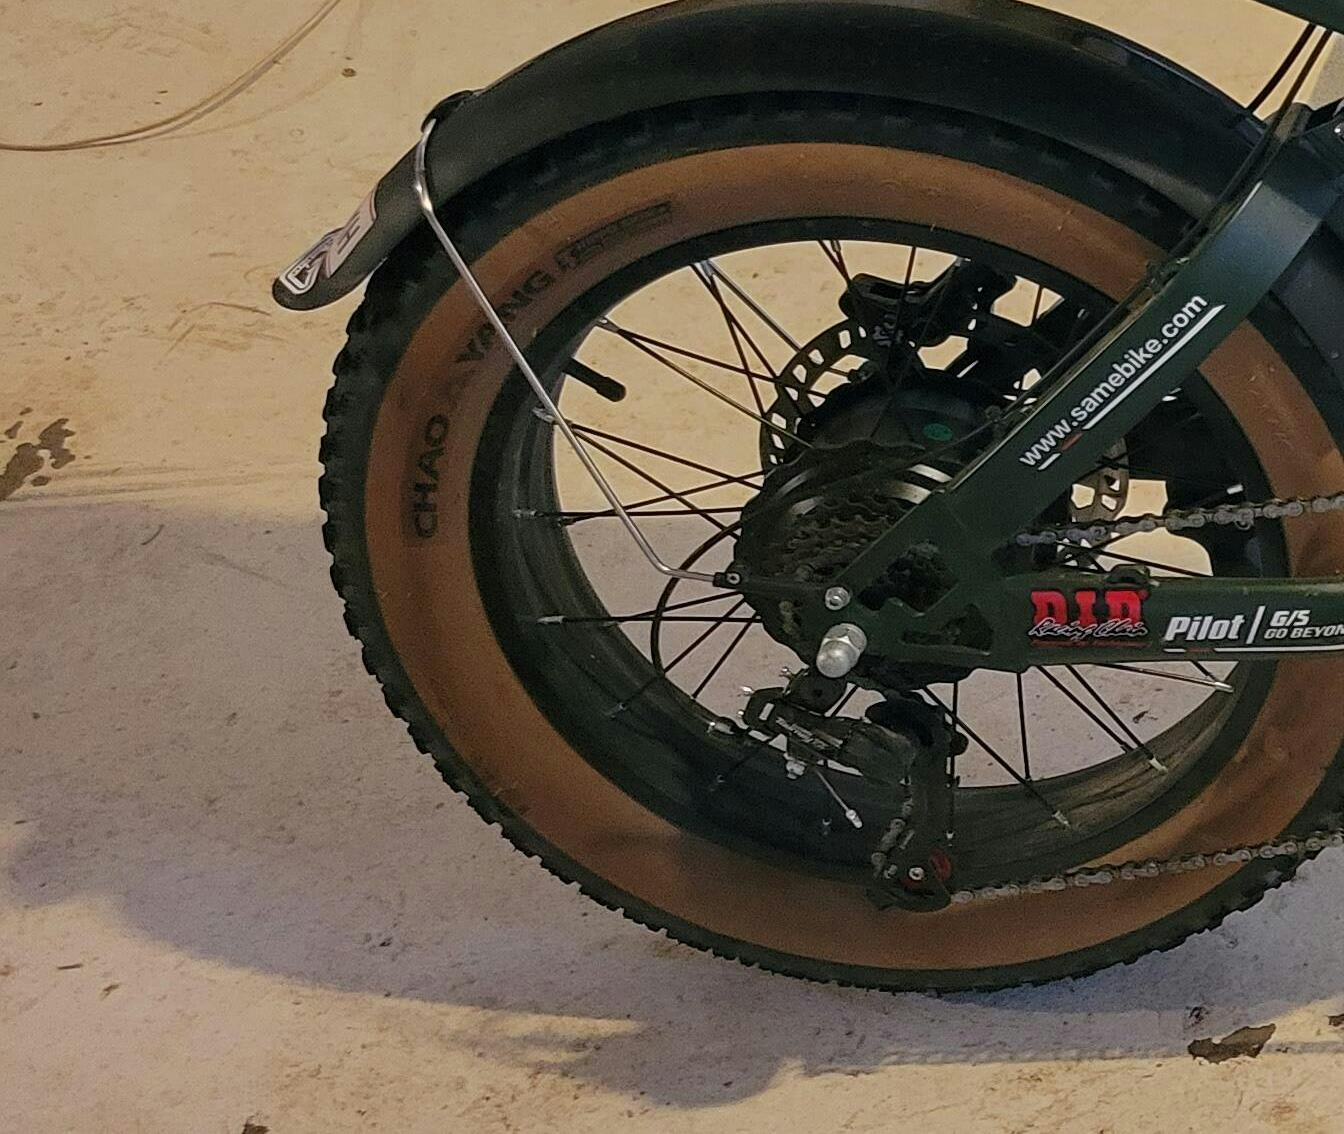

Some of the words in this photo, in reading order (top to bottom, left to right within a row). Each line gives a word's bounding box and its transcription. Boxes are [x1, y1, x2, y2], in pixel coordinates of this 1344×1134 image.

[1018, 294, 1208, 467] www.samebike.com
[412, 414, 449, 540] CHAO
[1163, 614, 1245, 642] Pilot
[1269, 609, 1311, 628] G/S
[1263, 627, 1290, 640] GO
